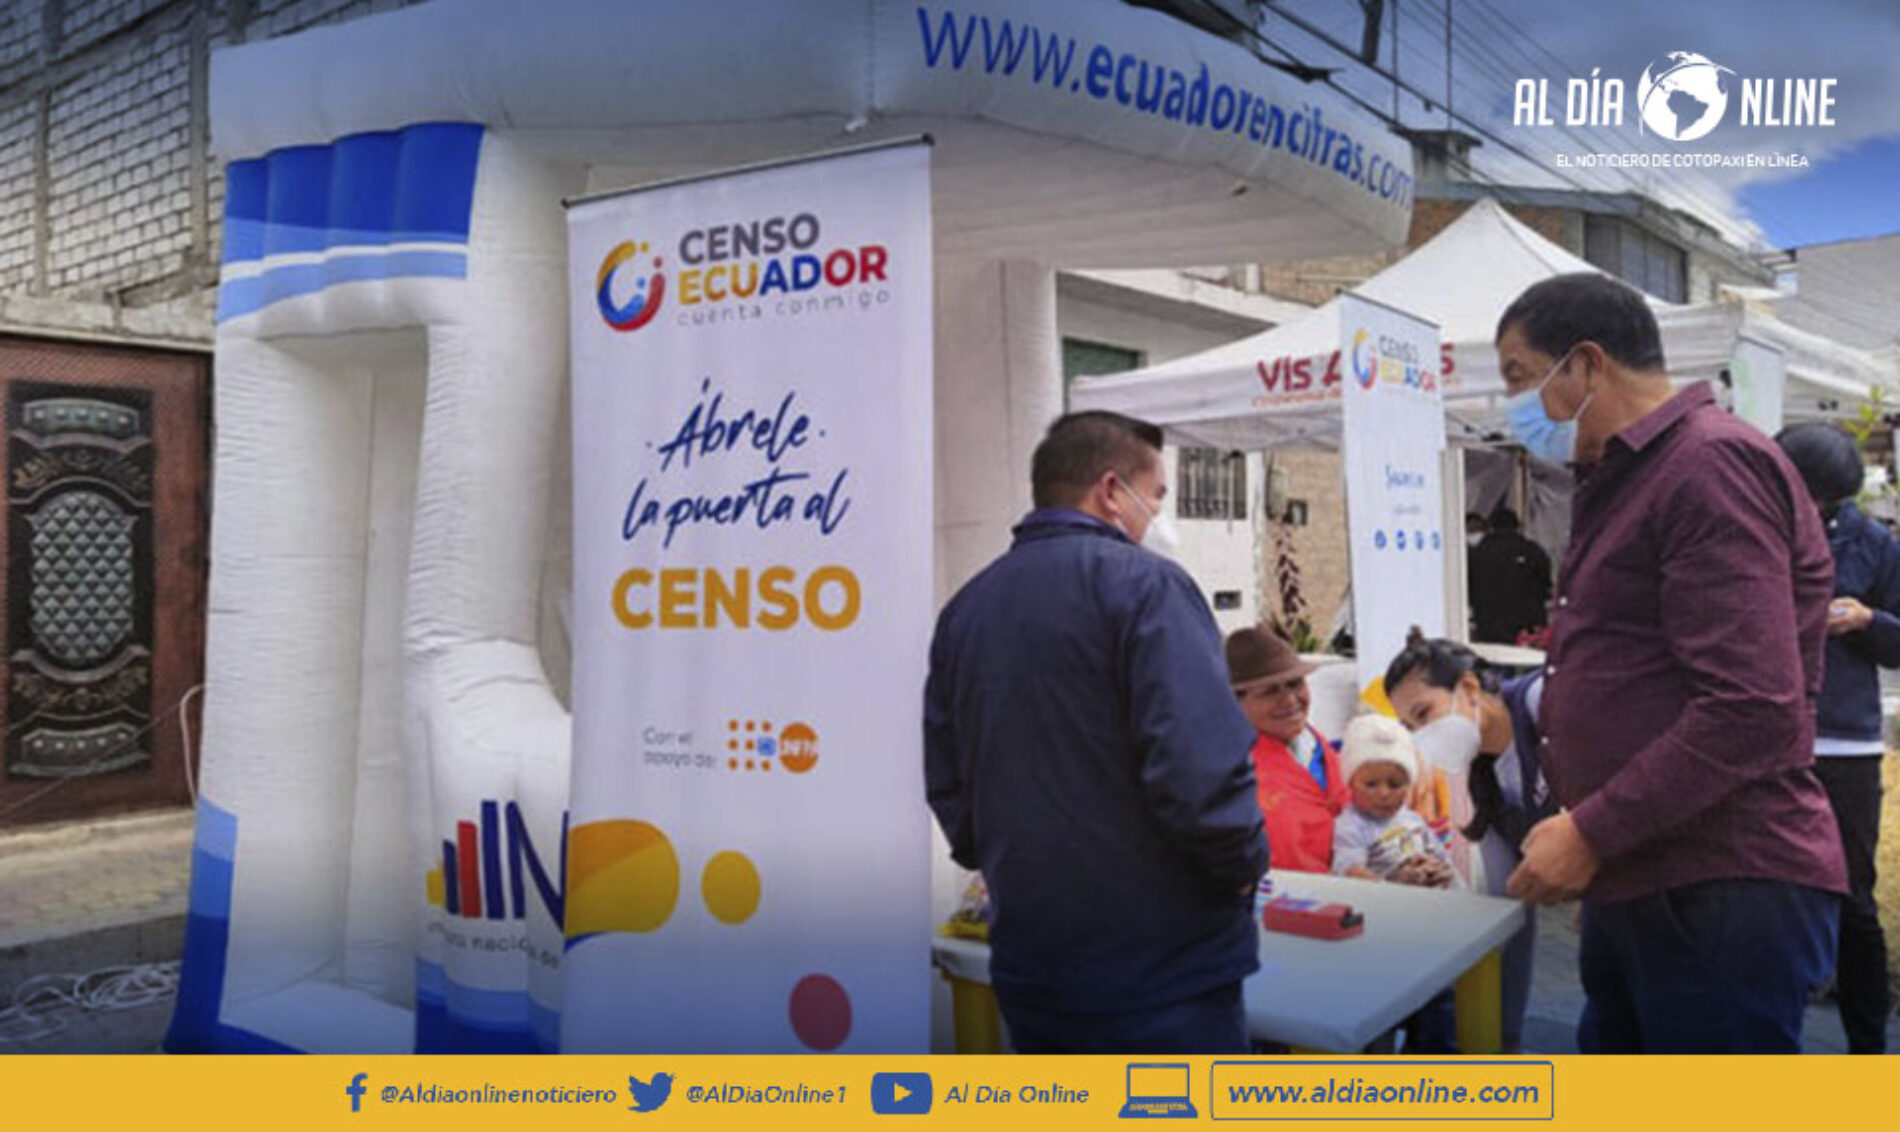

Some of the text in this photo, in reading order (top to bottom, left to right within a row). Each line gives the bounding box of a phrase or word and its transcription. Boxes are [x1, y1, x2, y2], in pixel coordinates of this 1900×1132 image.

[679, 213, 820, 265] CENSO
[678, 245, 888, 305] ECUADOR
[677, 289, 890, 327] cuenta conmigo
[658, 377, 809, 472] Ábrele
[622, 467, 851, 550] la puerta al
[611, 565, 862, 631] CENSO
[642, 726, 673, 745] Con
